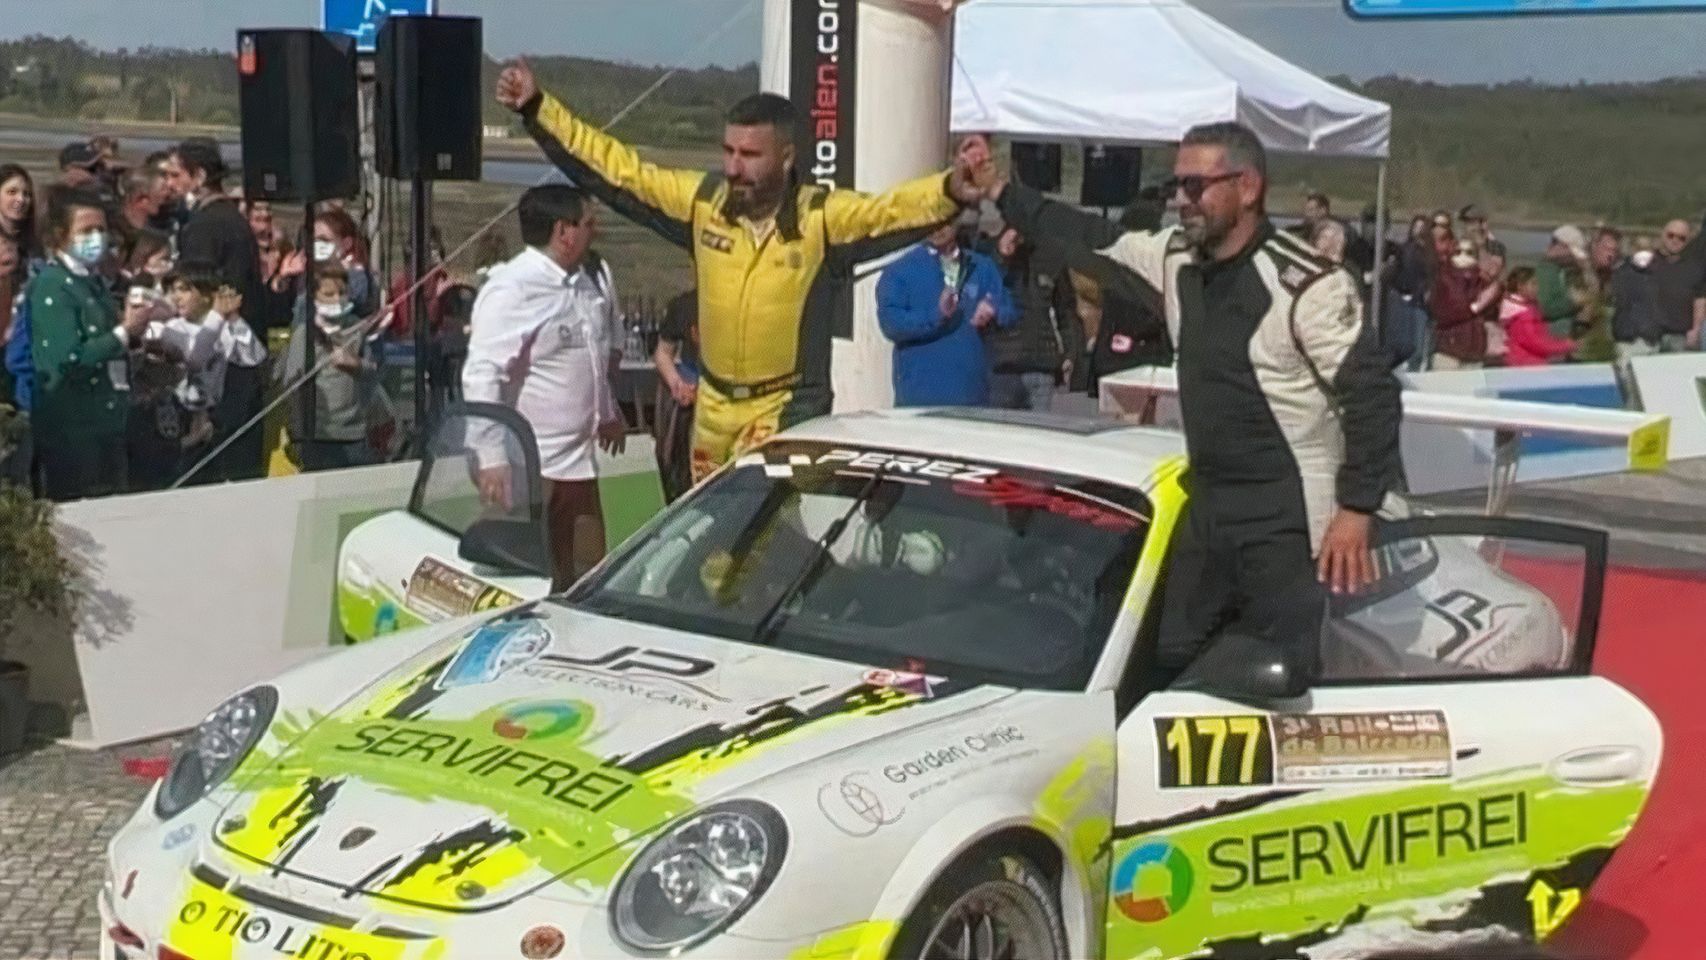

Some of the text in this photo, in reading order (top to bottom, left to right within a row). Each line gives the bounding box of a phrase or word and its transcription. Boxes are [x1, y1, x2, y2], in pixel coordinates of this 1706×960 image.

[816, 450, 1001, 483] PEREZ
[539, 646, 715, 677] JP
[336, 724, 634, 812] SERVIFREI
[883, 745, 969, 784] Garden
[1166, 717, 1262, 786] 177
[1207, 791, 1527, 893] SERVIFREI
[179, 900, 207, 925] O
[212, 904, 272, 943] TIO
